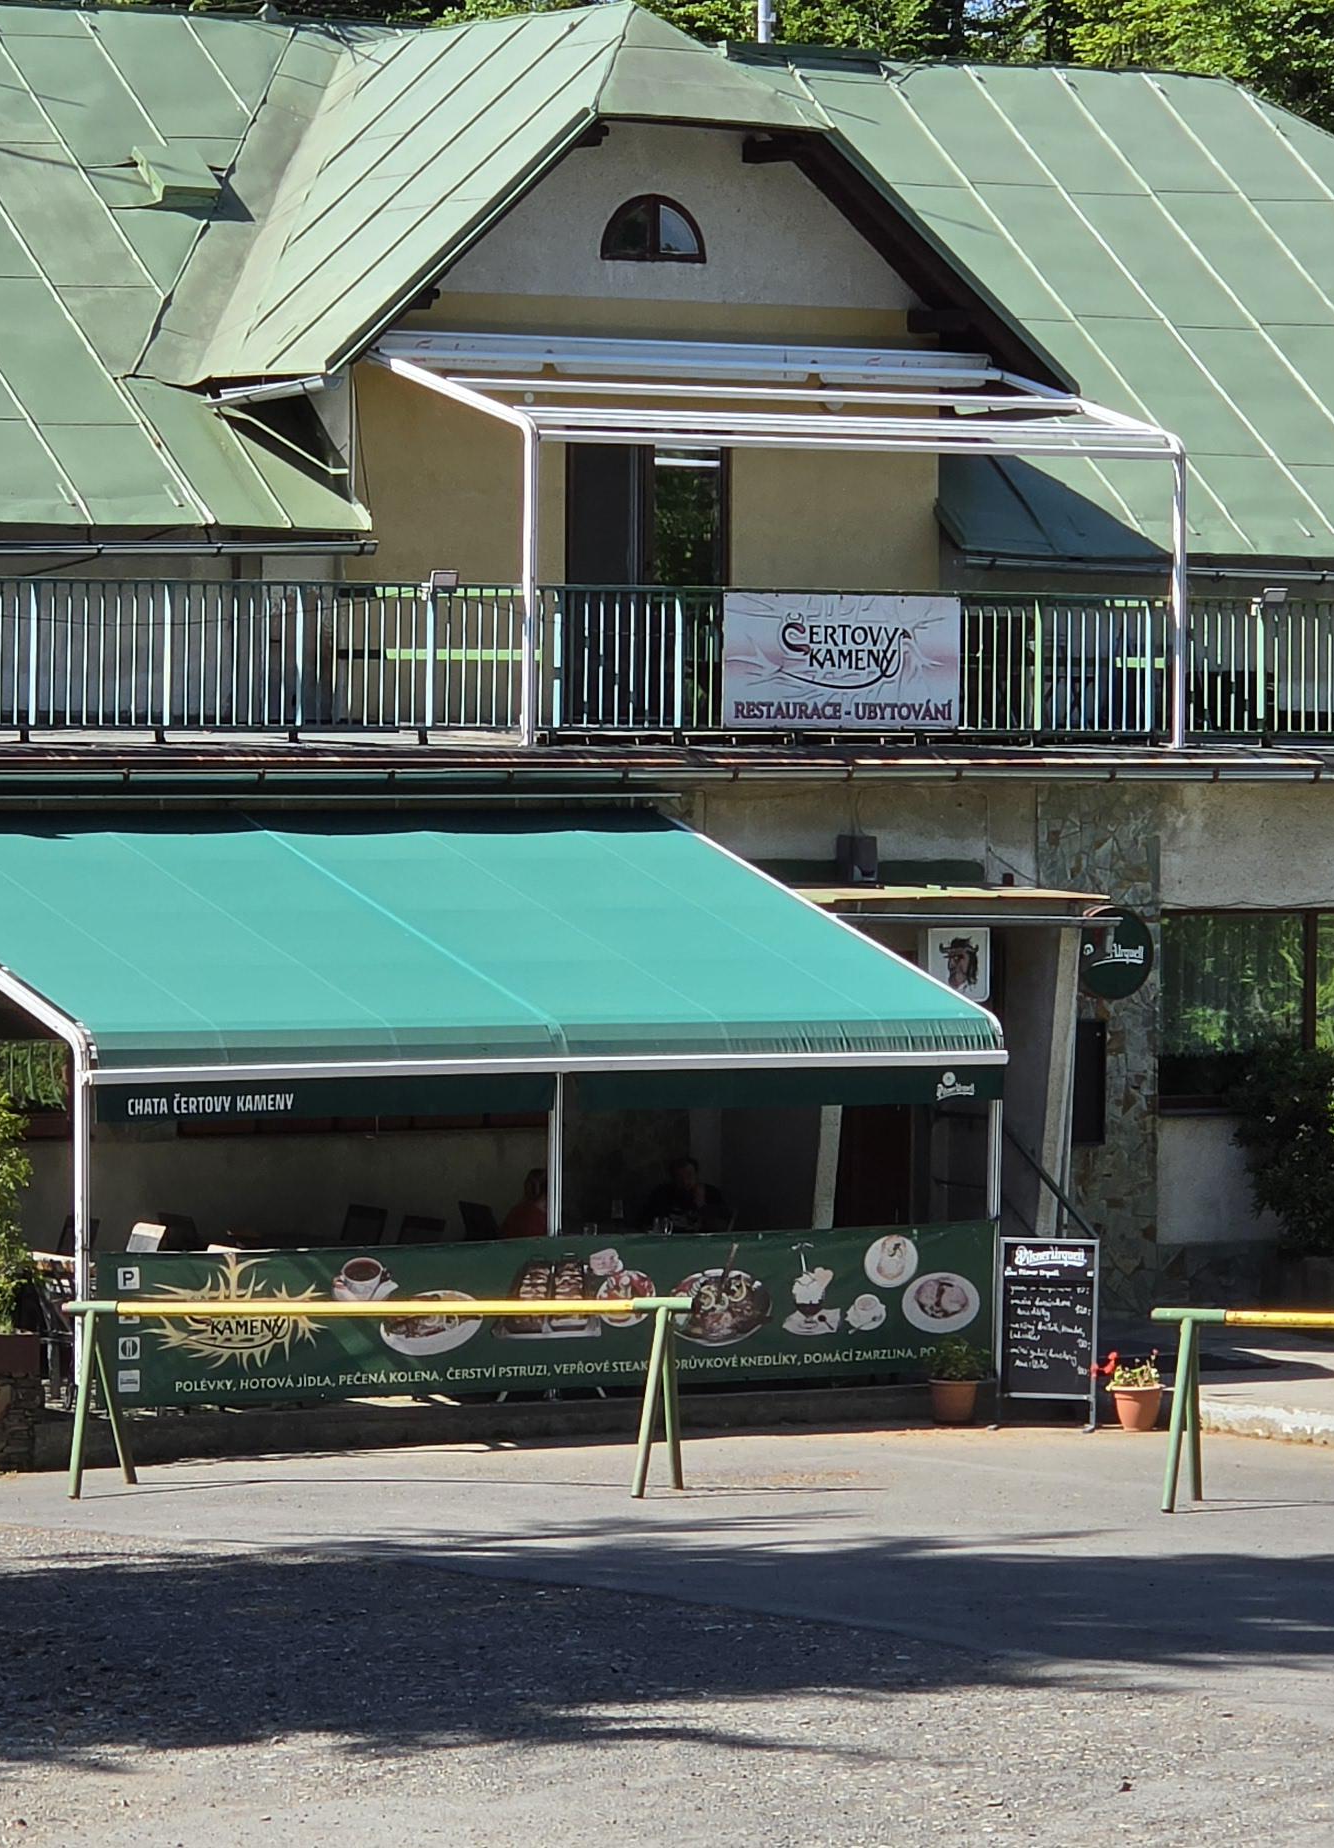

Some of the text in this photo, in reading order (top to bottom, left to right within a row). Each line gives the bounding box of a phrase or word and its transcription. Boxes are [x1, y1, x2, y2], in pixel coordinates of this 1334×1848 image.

[809, 648, 898, 675] KAMENY
[734, 701, 842, 720] RESTAURACE
[854, 699, 953, 721] UBYTOVÁNÍ
[127, 1092, 294, 1116] CHATA ČERTOVY KAMENY
[123, 1270, 134, 1287] P
[210, 1316, 286, 1338] KAMENY
[175, 1377, 237, 1393] POLÉVKY,
[240, 1374, 294, 1390] HOTOVÁ
[296, 1372, 336, 1388] JÍDLA,
[339, 1370, 388, 1386] PEČENÁ
[389, 1370, 444, 1384] KOLENA,
[446, 1364, 496, 1381] ČERSTVÍ
[498, 1364, 551, 1378] PSTRUZI,
[553, 1359, 610, 1375] VEPŘOVÉ
[612, 1360, 649, 1373] STEAK
[740, 1351, 801, 1367] KNEDLÍKY,
[804, 1348, 853, 1365] DOMÁCÍ
[855, 1347, 917, 1362] ZMRZLINA,
